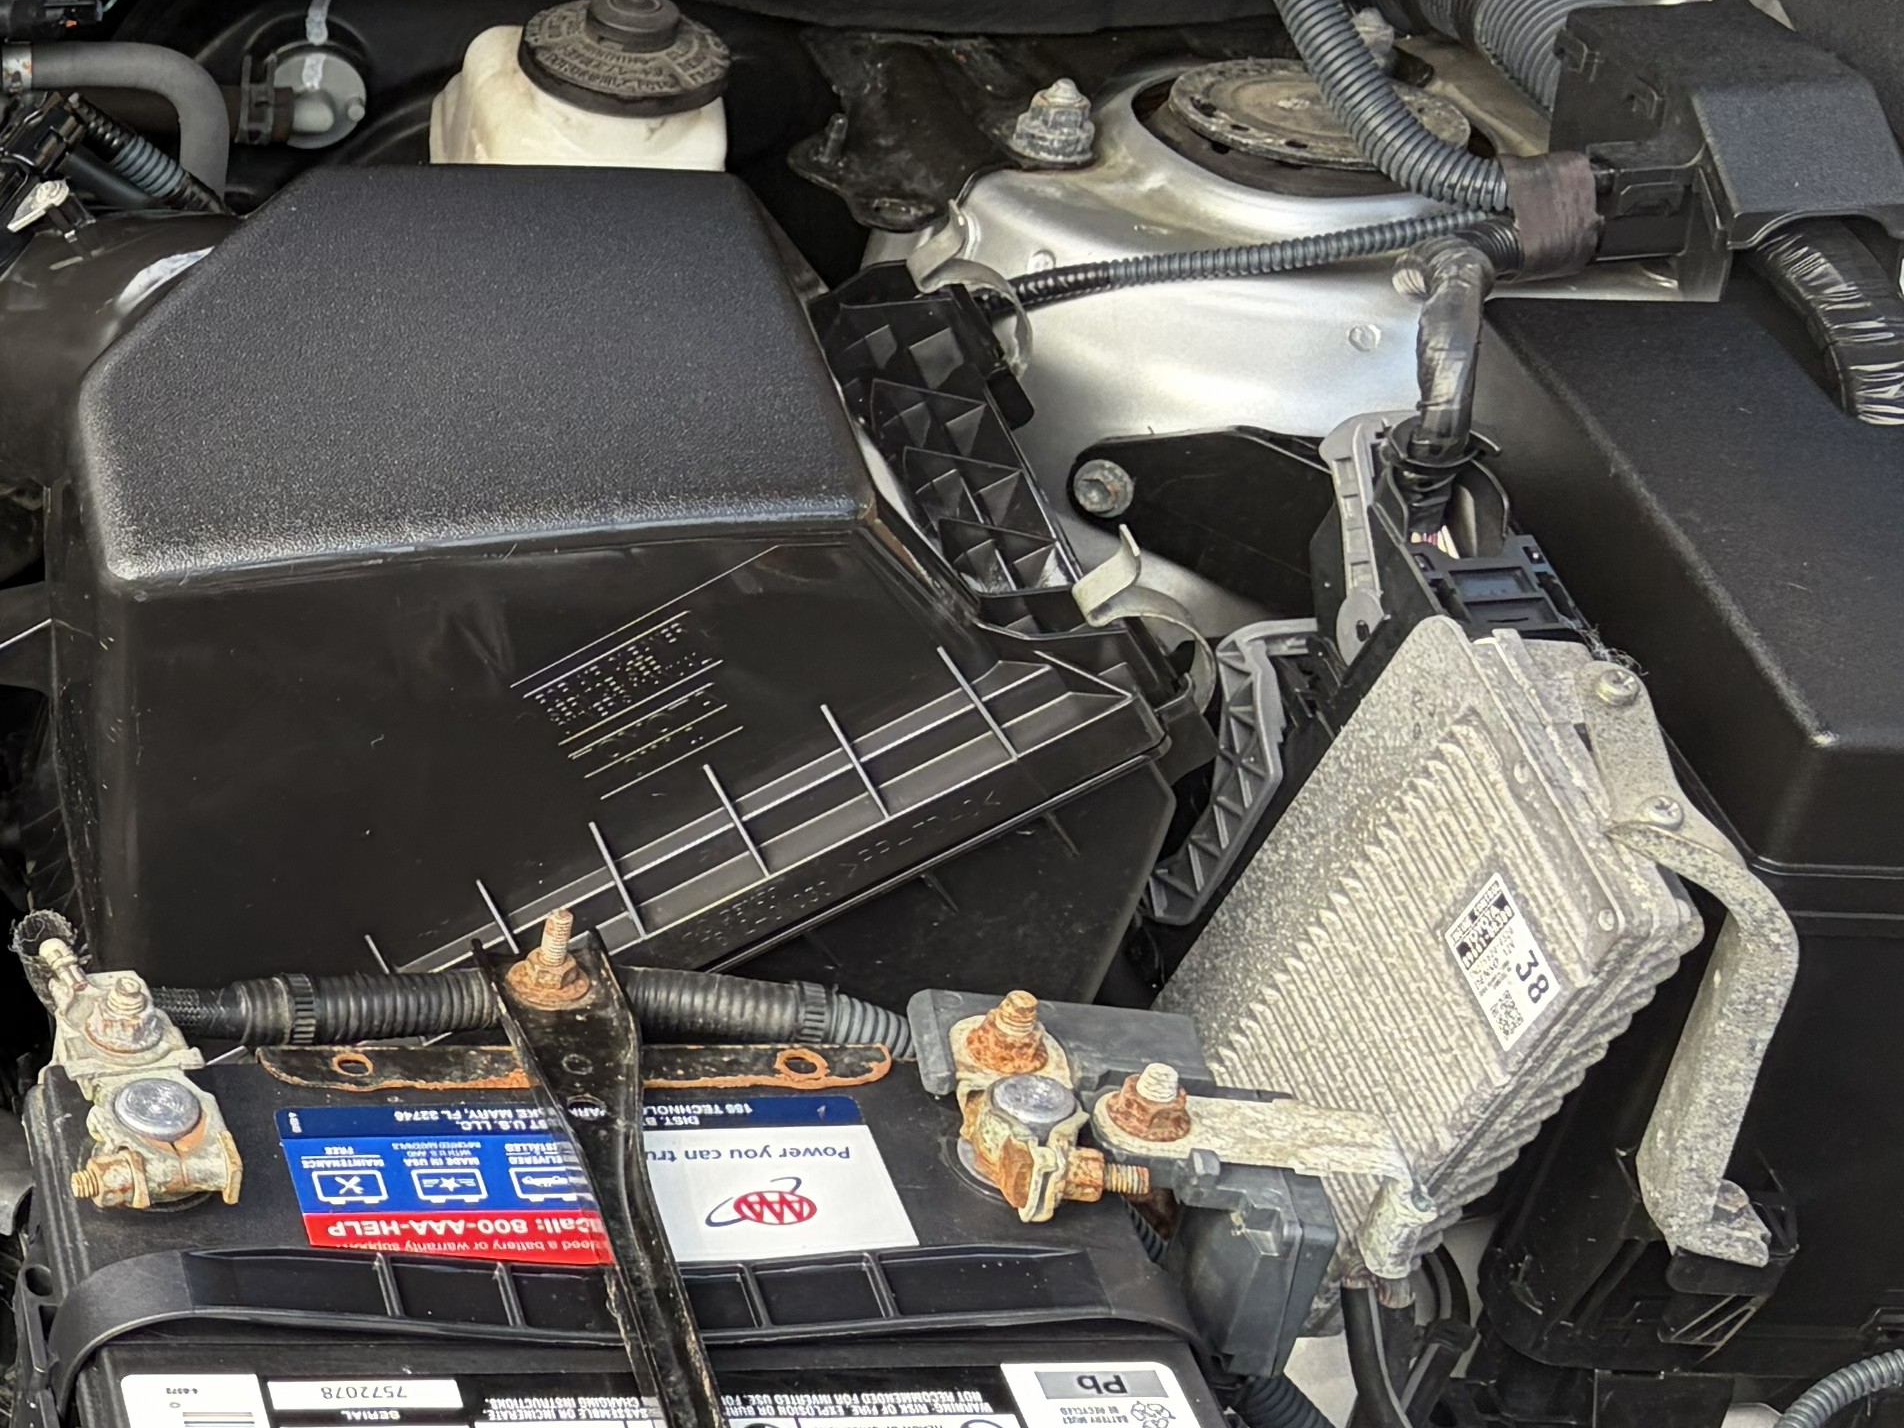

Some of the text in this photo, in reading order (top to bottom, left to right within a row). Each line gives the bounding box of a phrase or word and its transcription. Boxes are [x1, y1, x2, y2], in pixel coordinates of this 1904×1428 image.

[1516, 950, 1549, 1003] 38
[441, 1110, 462, 1120] FL
[642, 1104, 724, 1115] TECHNOL
[660, 1115, 700, 1125] DIST.
[684, 1149, 722, 1161] can
[729, 1144, 773, 1159] you
[779, 1146, 851, 1161] Power
[301, 1158, 385, 1168] MAINTENANCE
[403, 1156, 480, 1167] MADE IN USA
[734, 1192, 812, 1223] AAA
[327, 1217, 593, 1237] Call: 800-AAA-HELP
[404, 1239, 469, 1252] warranty
[473, 1240, 488, 1250] or
[492, 1239, 544, 1252] battery
[1077, 1375, 1129, 1394] Pb
[320, 1385, 408, 1399] 7572078
[861, 1391, 955, 1405] RECOMMENDED
[340, 1409, 401, 1420] SERIAL
